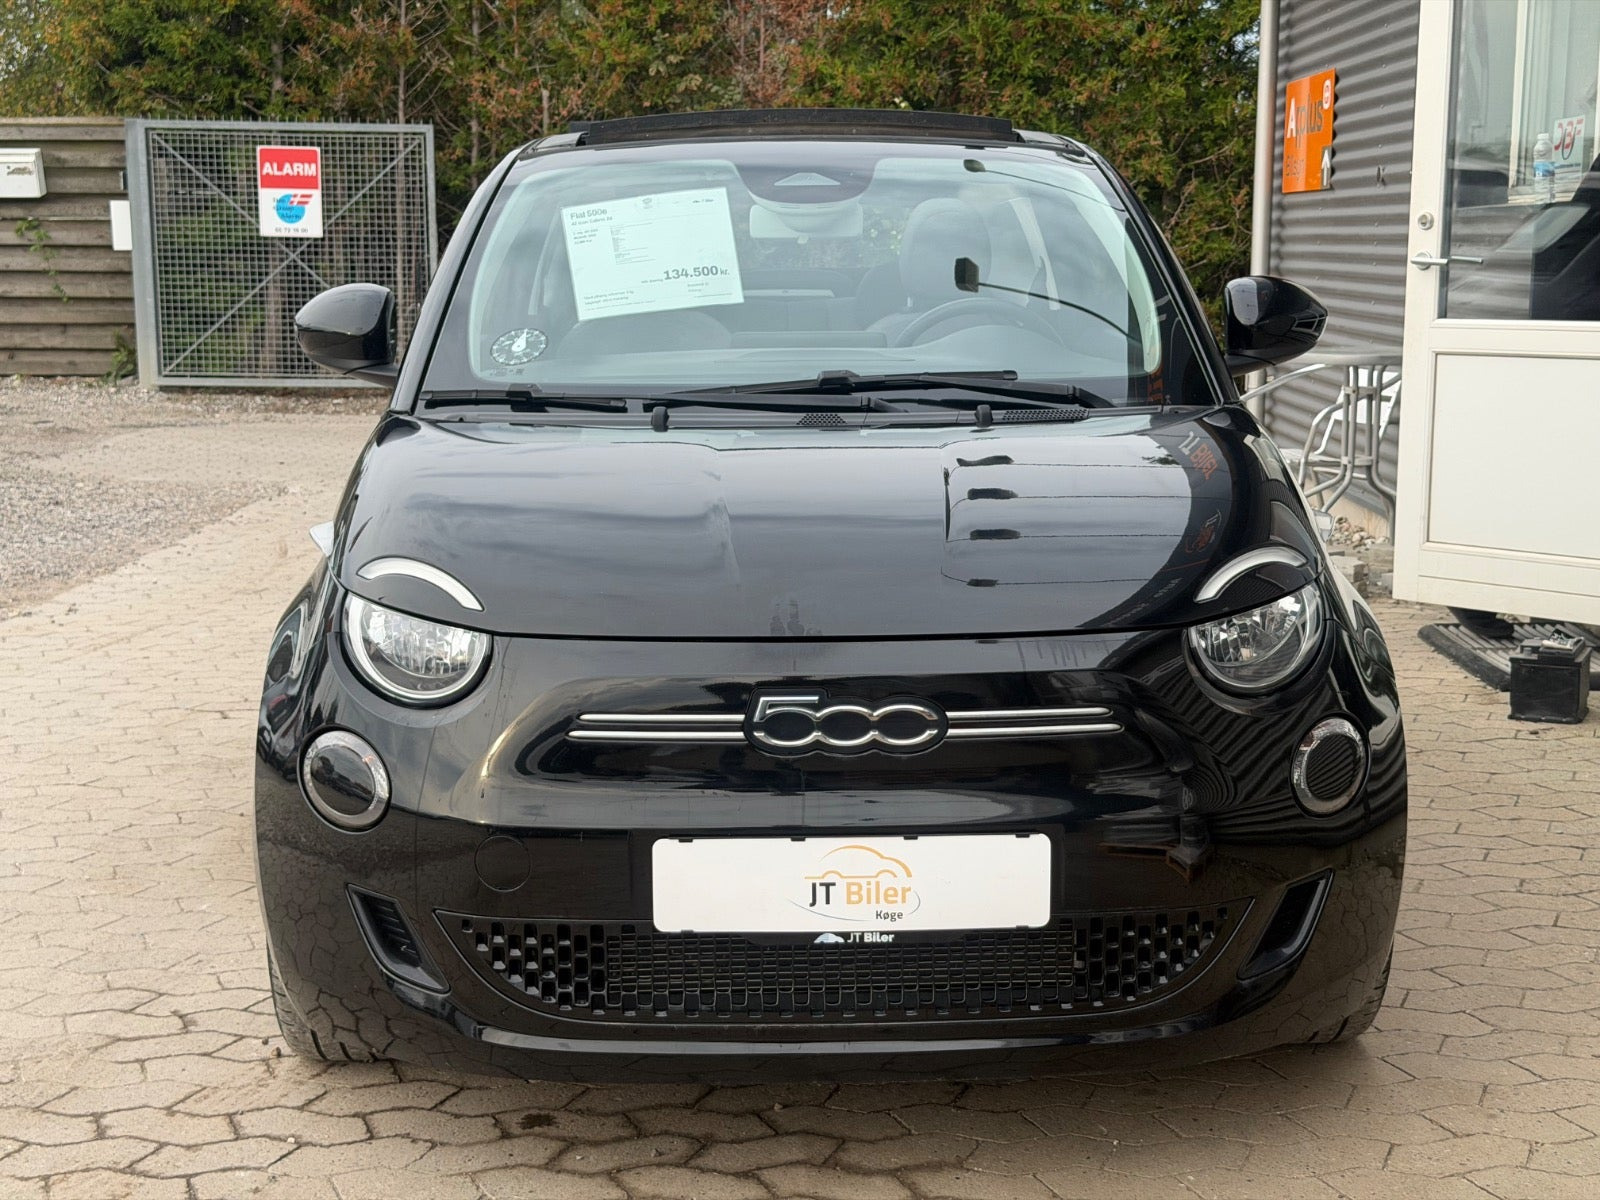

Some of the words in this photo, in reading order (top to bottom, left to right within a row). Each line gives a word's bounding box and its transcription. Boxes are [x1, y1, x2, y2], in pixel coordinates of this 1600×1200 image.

[262, 162, 317, 177] ALARM
[570, 211, 586, 220] Fiat
[664, 265, 719, 280] 134.500
[719, 267, 730, 276] kr.
[753, 696, 939, 747] 500
[809, 882, 837, 907] JT
[845, 880, 912, 905] Biler
[875, 910, 904, 922] Køge
[847, 932, 863, 943] JT
[863, 932, 895, 943] Biler
